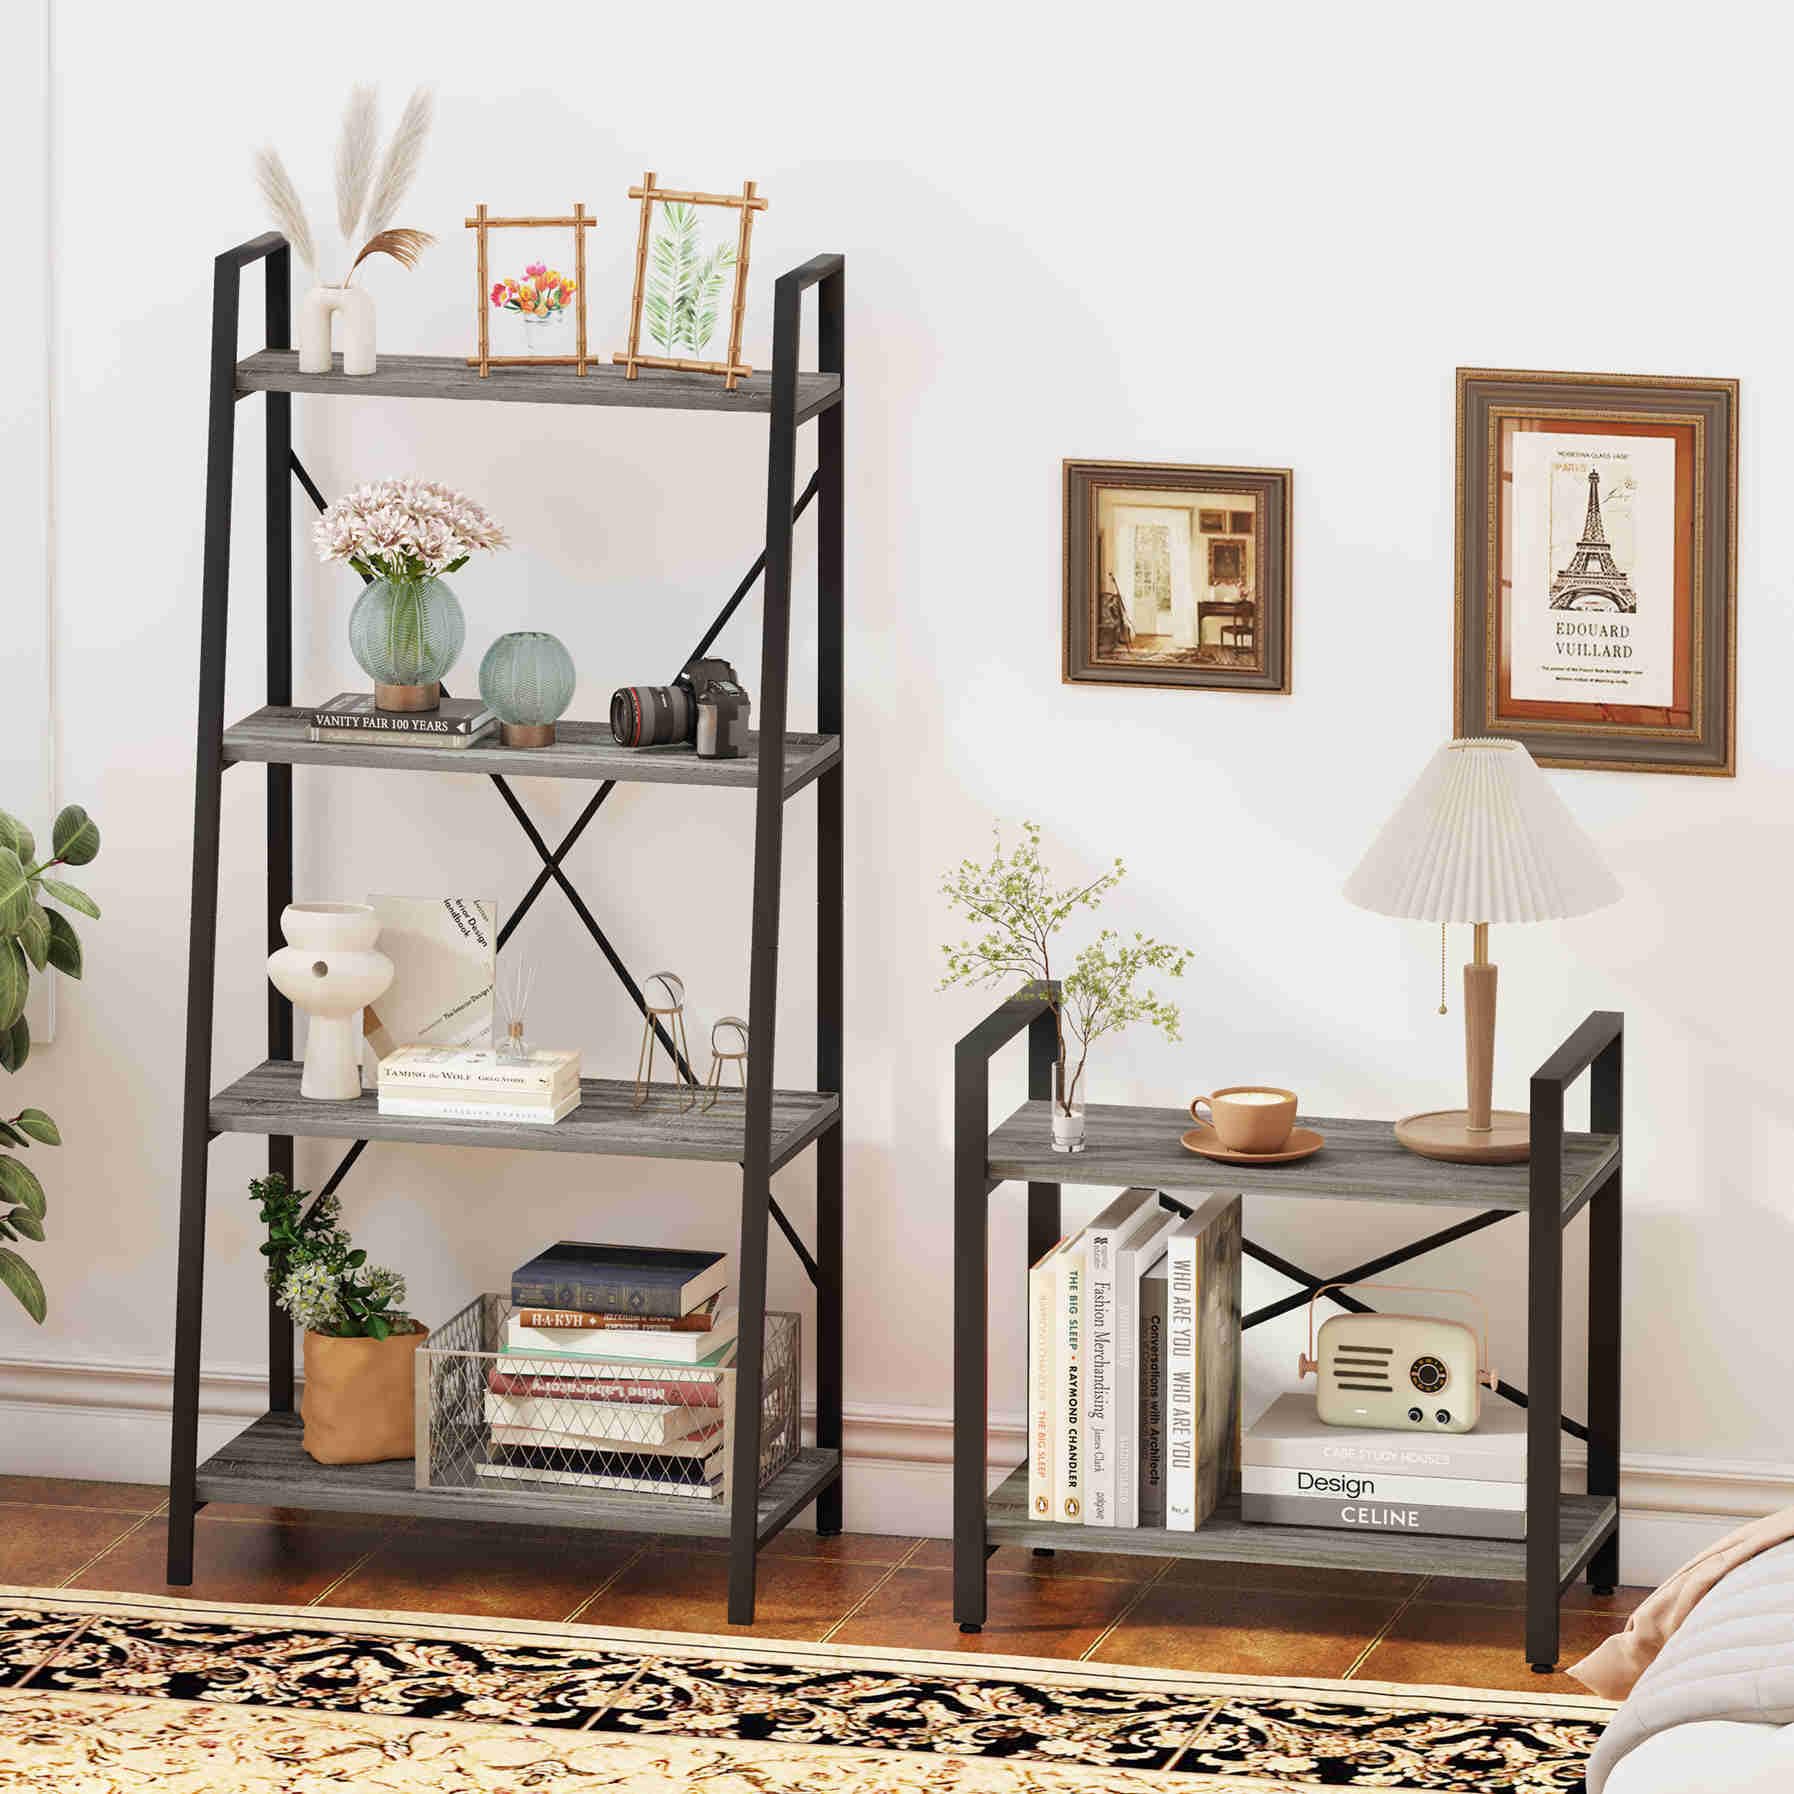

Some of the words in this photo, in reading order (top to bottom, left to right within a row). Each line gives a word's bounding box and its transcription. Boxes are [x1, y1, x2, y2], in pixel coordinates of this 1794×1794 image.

[1556, 621, 1630, 638] EDOUARD
[1555, 641, 1633, 658] VUILLARD
[315, 714, 360, 728] VANITY
[362, 716, 389, 729] FAIR
[392, 718, 409, 730] 100
[411, 719, 449, 732] YEARS
[468, 917, 488, 948] Design
[1068, 1271, 1079, 1291] THE
[1172, 1260, 1192, 1292] WHO
[1068, 1295, 1079, 1315] BIG
[1093, 1282, 1112, 1327] Fashion
[1172, 1296, 1192, 1324] ARE
[1068, 1319, 1079, 1351] SLEEP
[1172, 1329, 1192, 1357] YOU
[1150, 1315, 1161, 1398] Conversations
[1088, 1332, 1112, 1420] Merchandising
[1172, 1371, 1191, 1403] WHO
[1068, 1365, 1079, 1425] RAYMOND
[1150, 1401, 1161, 1424] with
[1172, 1408, 1191, 1436] ARE
[1068, 1428, 1078, 1488] CHANDLER
[1150, 1429, 1161, 1486] Architects
[1172, 1440, 1191, 1469] YOU
[1298, 1471, 1375, 1498] Design
[1340, 1506, 1420, 1528] CELINE
